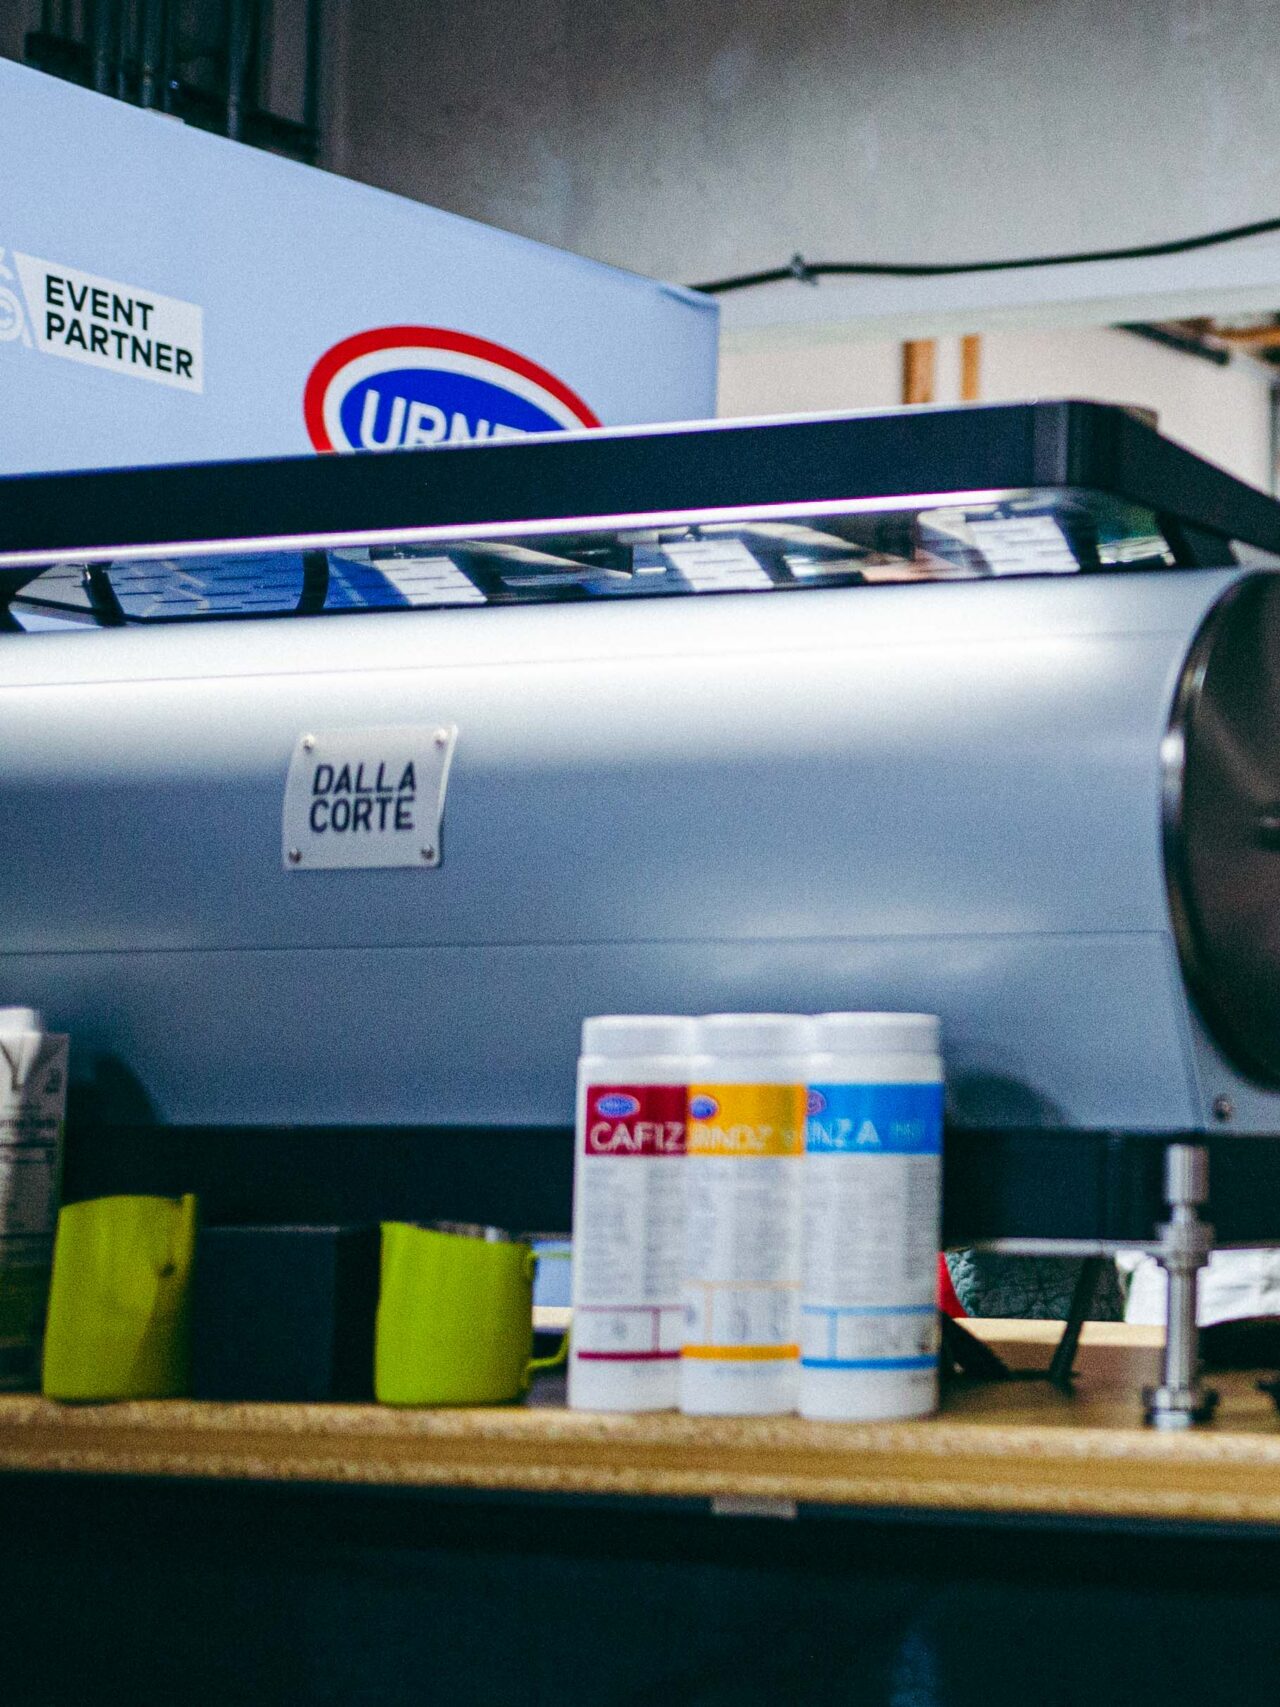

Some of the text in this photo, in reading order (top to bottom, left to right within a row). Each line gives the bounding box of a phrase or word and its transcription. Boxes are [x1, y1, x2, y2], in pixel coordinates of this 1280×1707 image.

[46, 274, 154, 331] EVENT
[46, 311, 193, 379] PARTNER
[360, 388, 527, 451] URN
[312, 760, 417, 796] DALLA
[309, 794, 416, 834] CORTE
